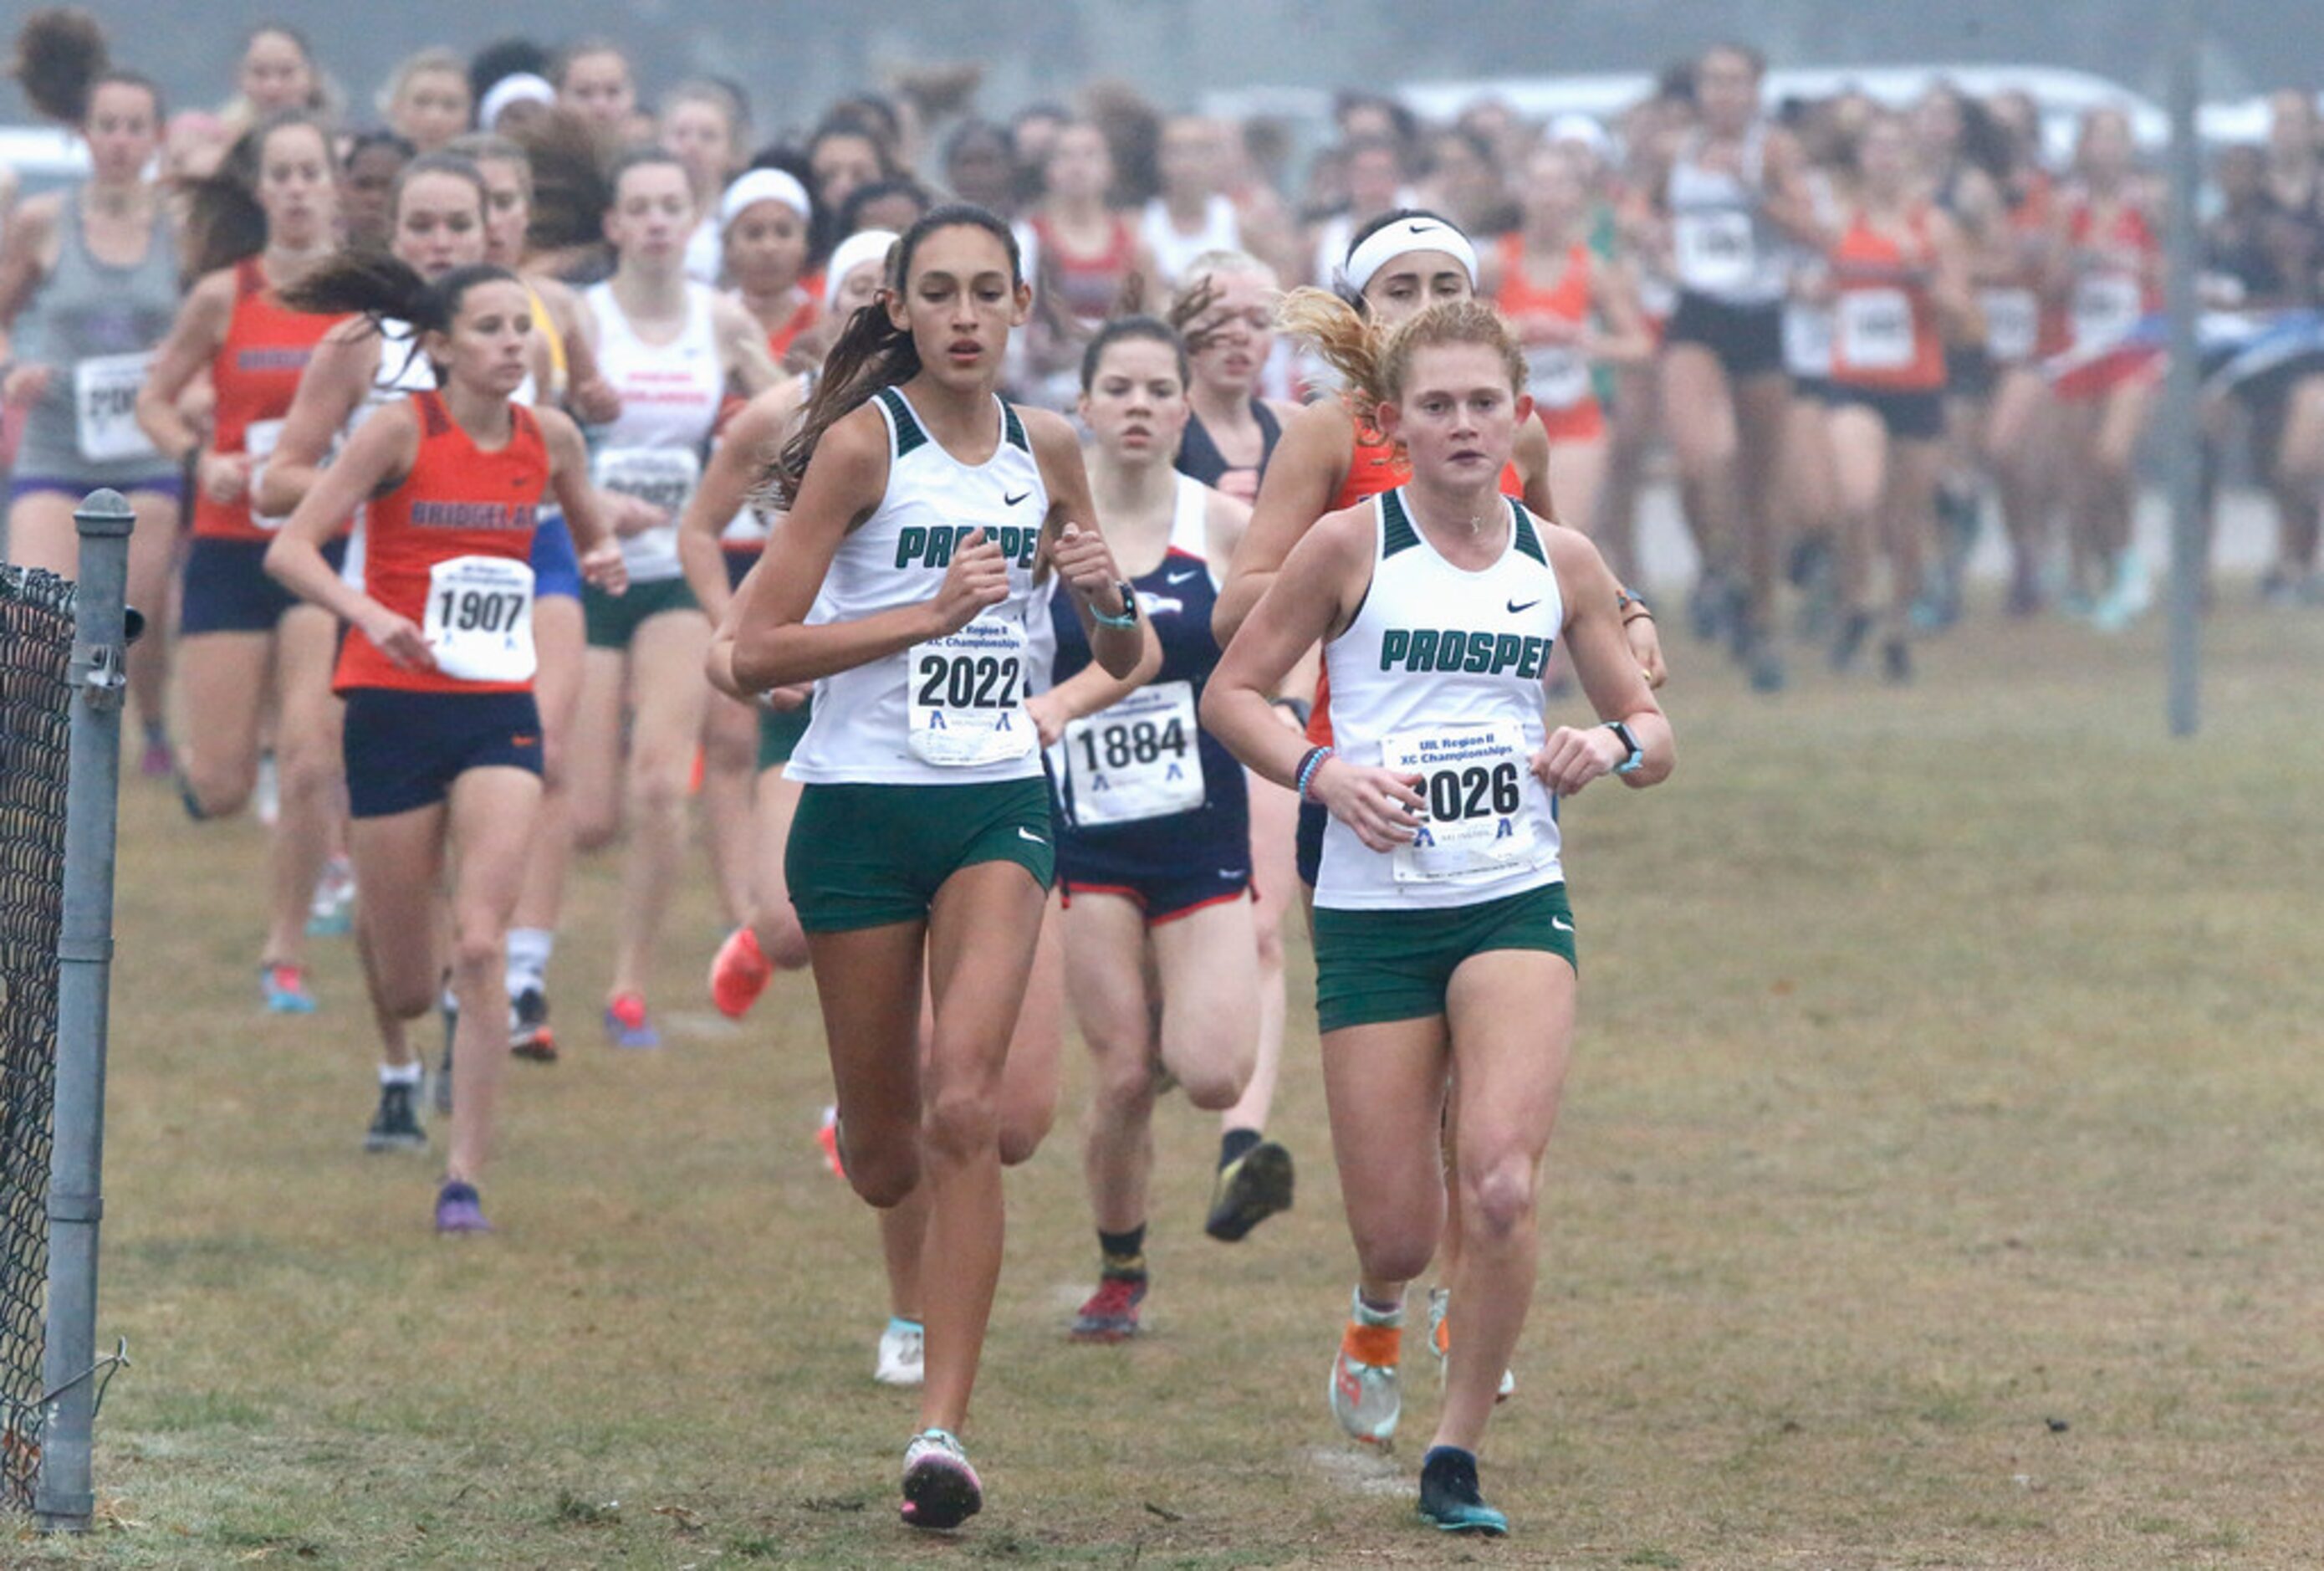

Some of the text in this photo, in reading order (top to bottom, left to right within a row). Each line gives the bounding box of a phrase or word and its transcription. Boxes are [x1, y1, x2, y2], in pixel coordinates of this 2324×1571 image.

[411, 502, 536, 530] BRIDGELA
[895, 526, 1042, 568] PRPE
[440, 590, 524, 632] 1907
[918, 655, 1019, 709] 2022
[1077, 717, 1187, 771] 1884
[1401, 745, 1513, 765] XC Championships
[1419, 740, 1438, 751] UIL
[1442, 735, 1484, 750] Region
